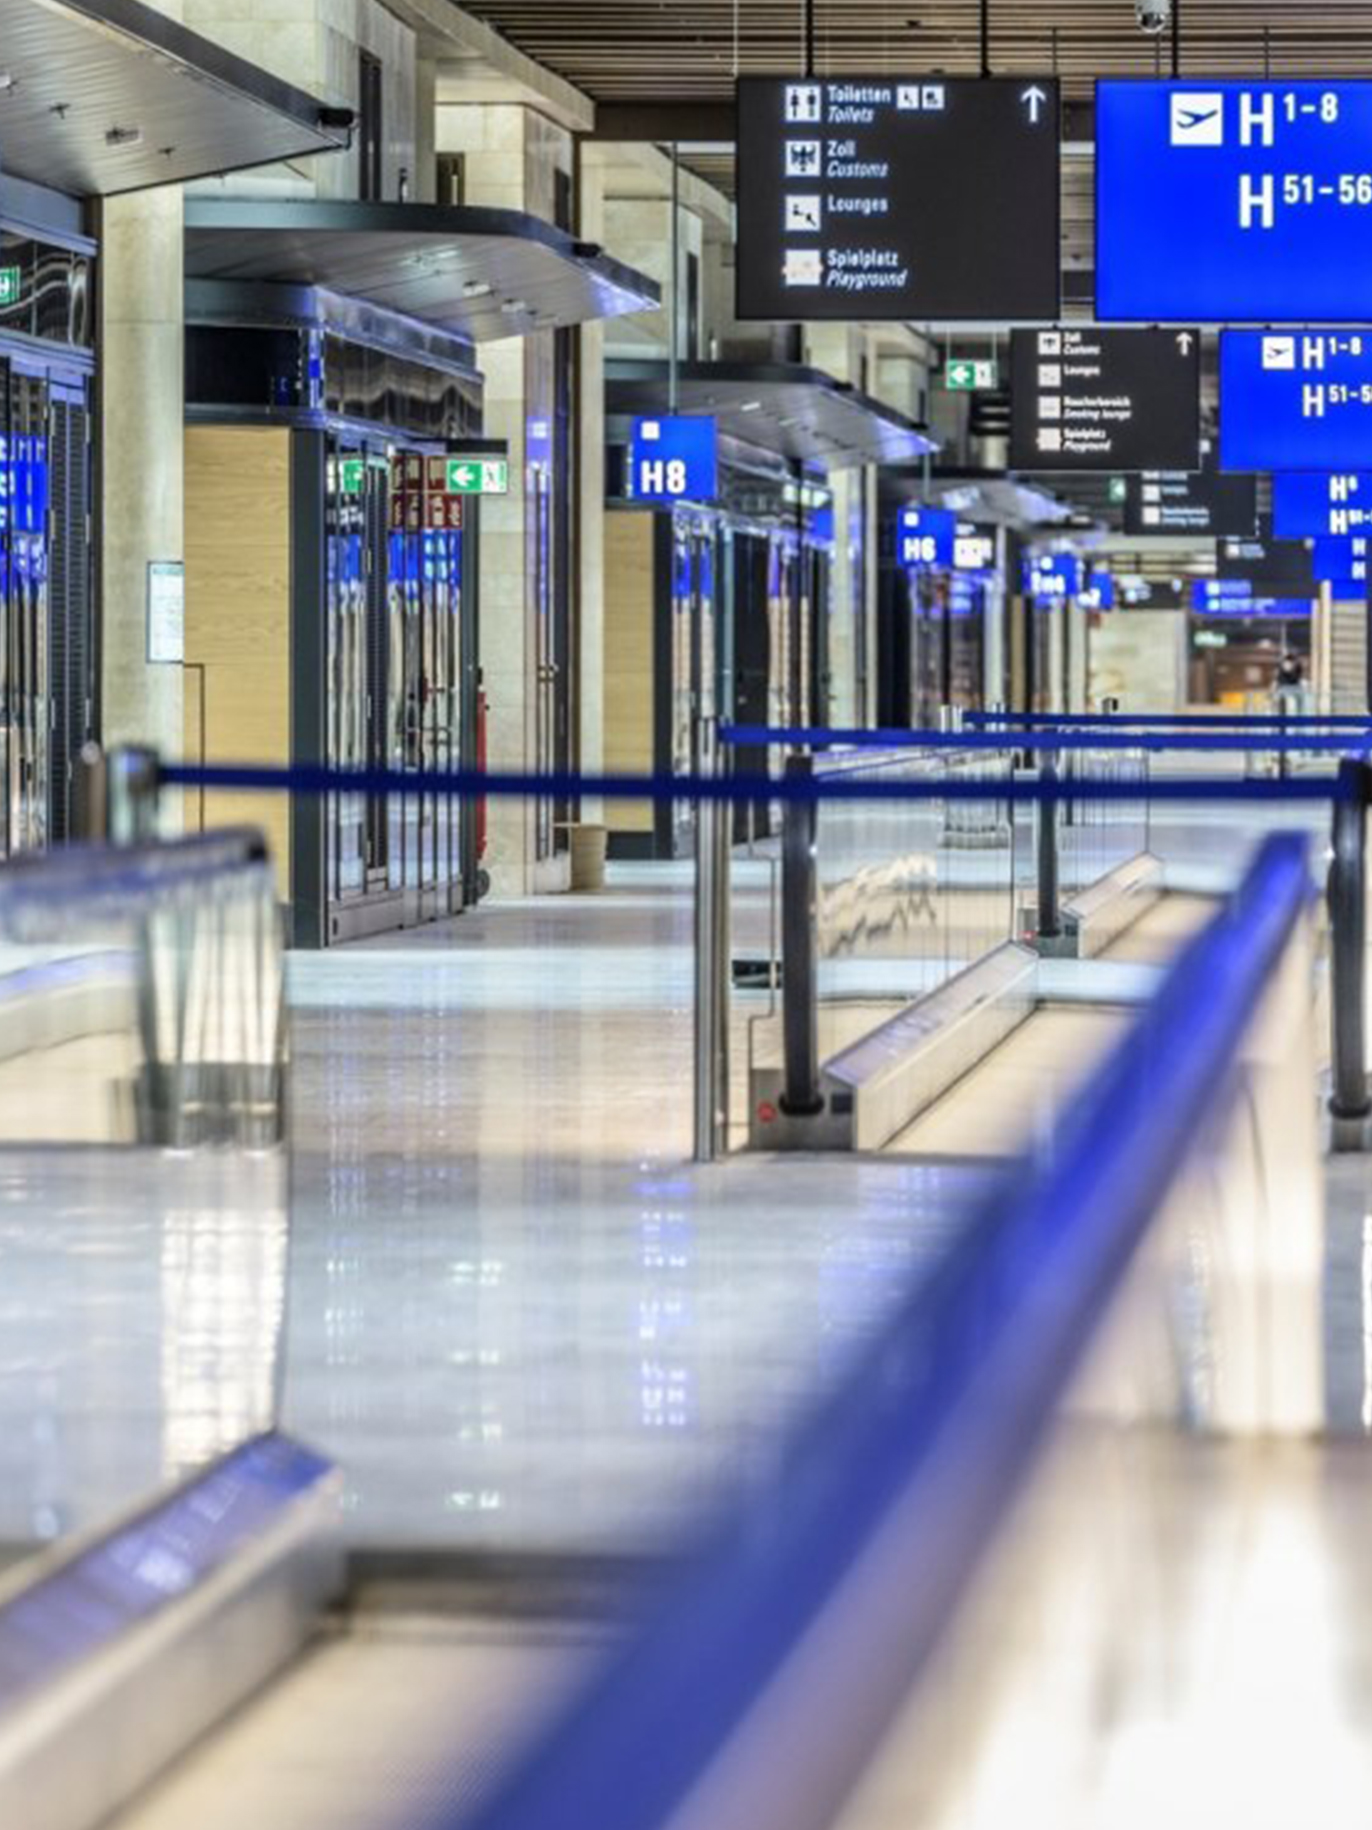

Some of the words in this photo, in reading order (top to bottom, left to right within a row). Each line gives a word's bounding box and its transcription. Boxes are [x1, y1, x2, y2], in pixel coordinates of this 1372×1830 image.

[827, 84, 891, 103] Toiletten
[827, 105, 875, 123] Toilets
[827, 139, 856, 157] Zoll
[827, 160, 888, 178] Customs
[827, 195, 888, 215] Lounges
[827, 249, 899, 269] Spielplatz
[826, 269, 908, 291] Playground
[641, 459, 686, 495] H8
[904, 536, 937, 563] H6
